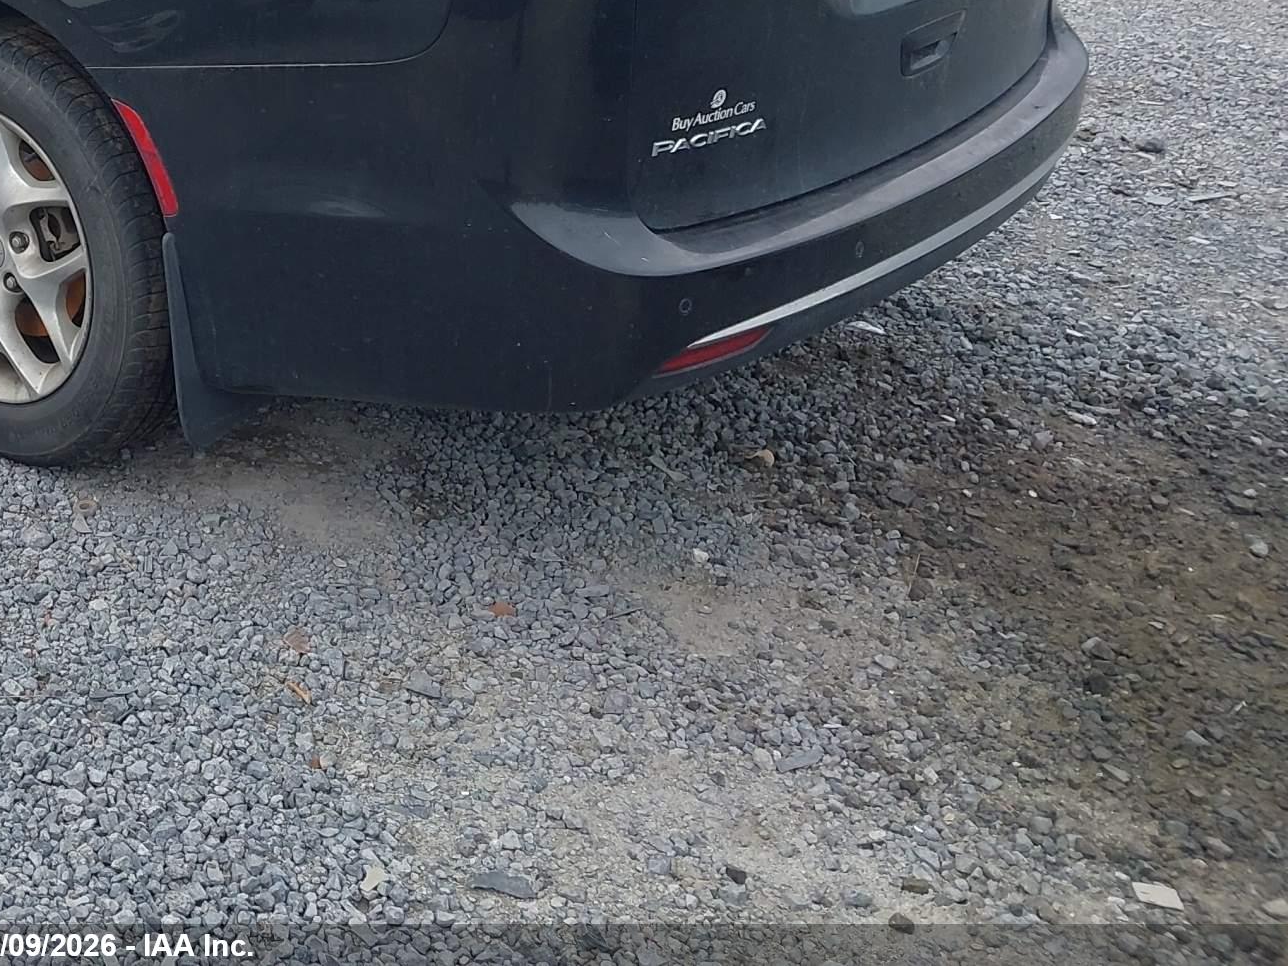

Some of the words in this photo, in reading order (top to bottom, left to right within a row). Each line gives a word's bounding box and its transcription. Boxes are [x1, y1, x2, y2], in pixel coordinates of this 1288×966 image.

[672, 117, 694, 132] Buy
[693, 107, 734, 127] Auction
[734, 101, 756, 116] Cars
[651, 118, 767, 157] PACIFICA
